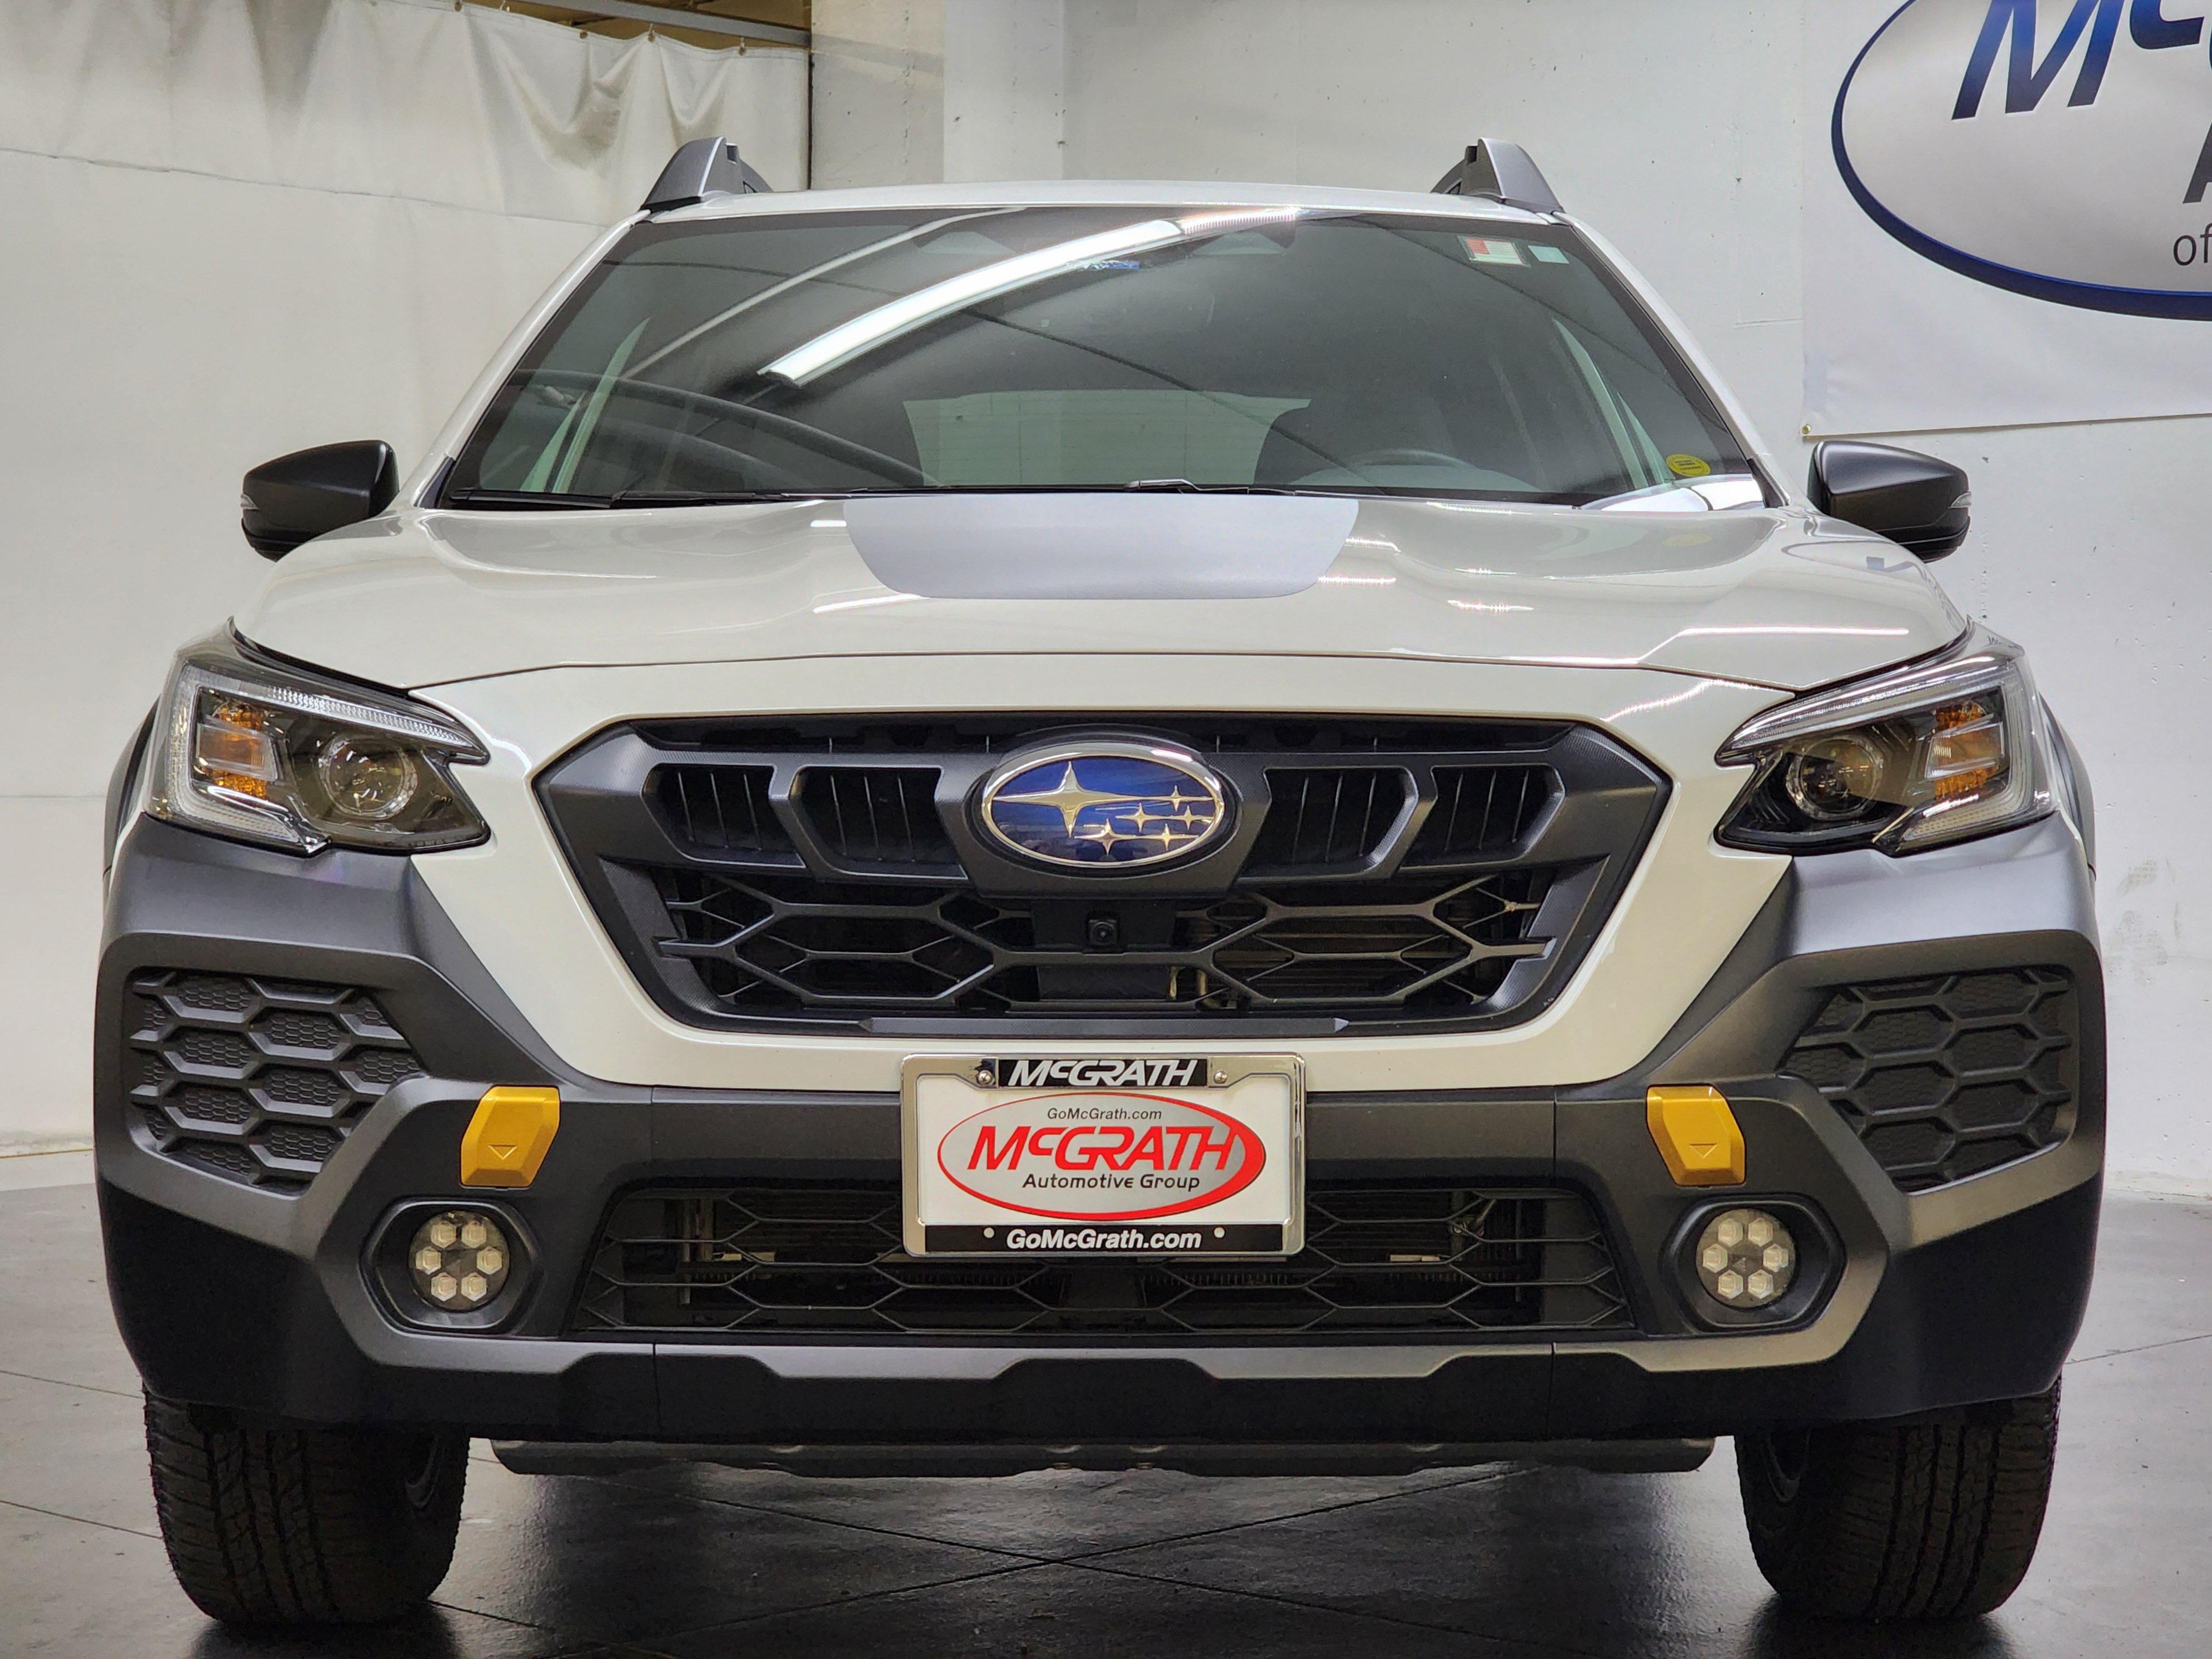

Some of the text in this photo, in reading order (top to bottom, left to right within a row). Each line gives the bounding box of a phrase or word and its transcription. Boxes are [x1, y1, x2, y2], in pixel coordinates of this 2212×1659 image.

[2173, 222, 2212, 266] of
[1047, 1107, 1162, 1120] GoMcGrath.com
[1022, 1173, 1200, 1192] Automotive Group
[1007, 1229, 1202, 1249] GoMcGrath.com
